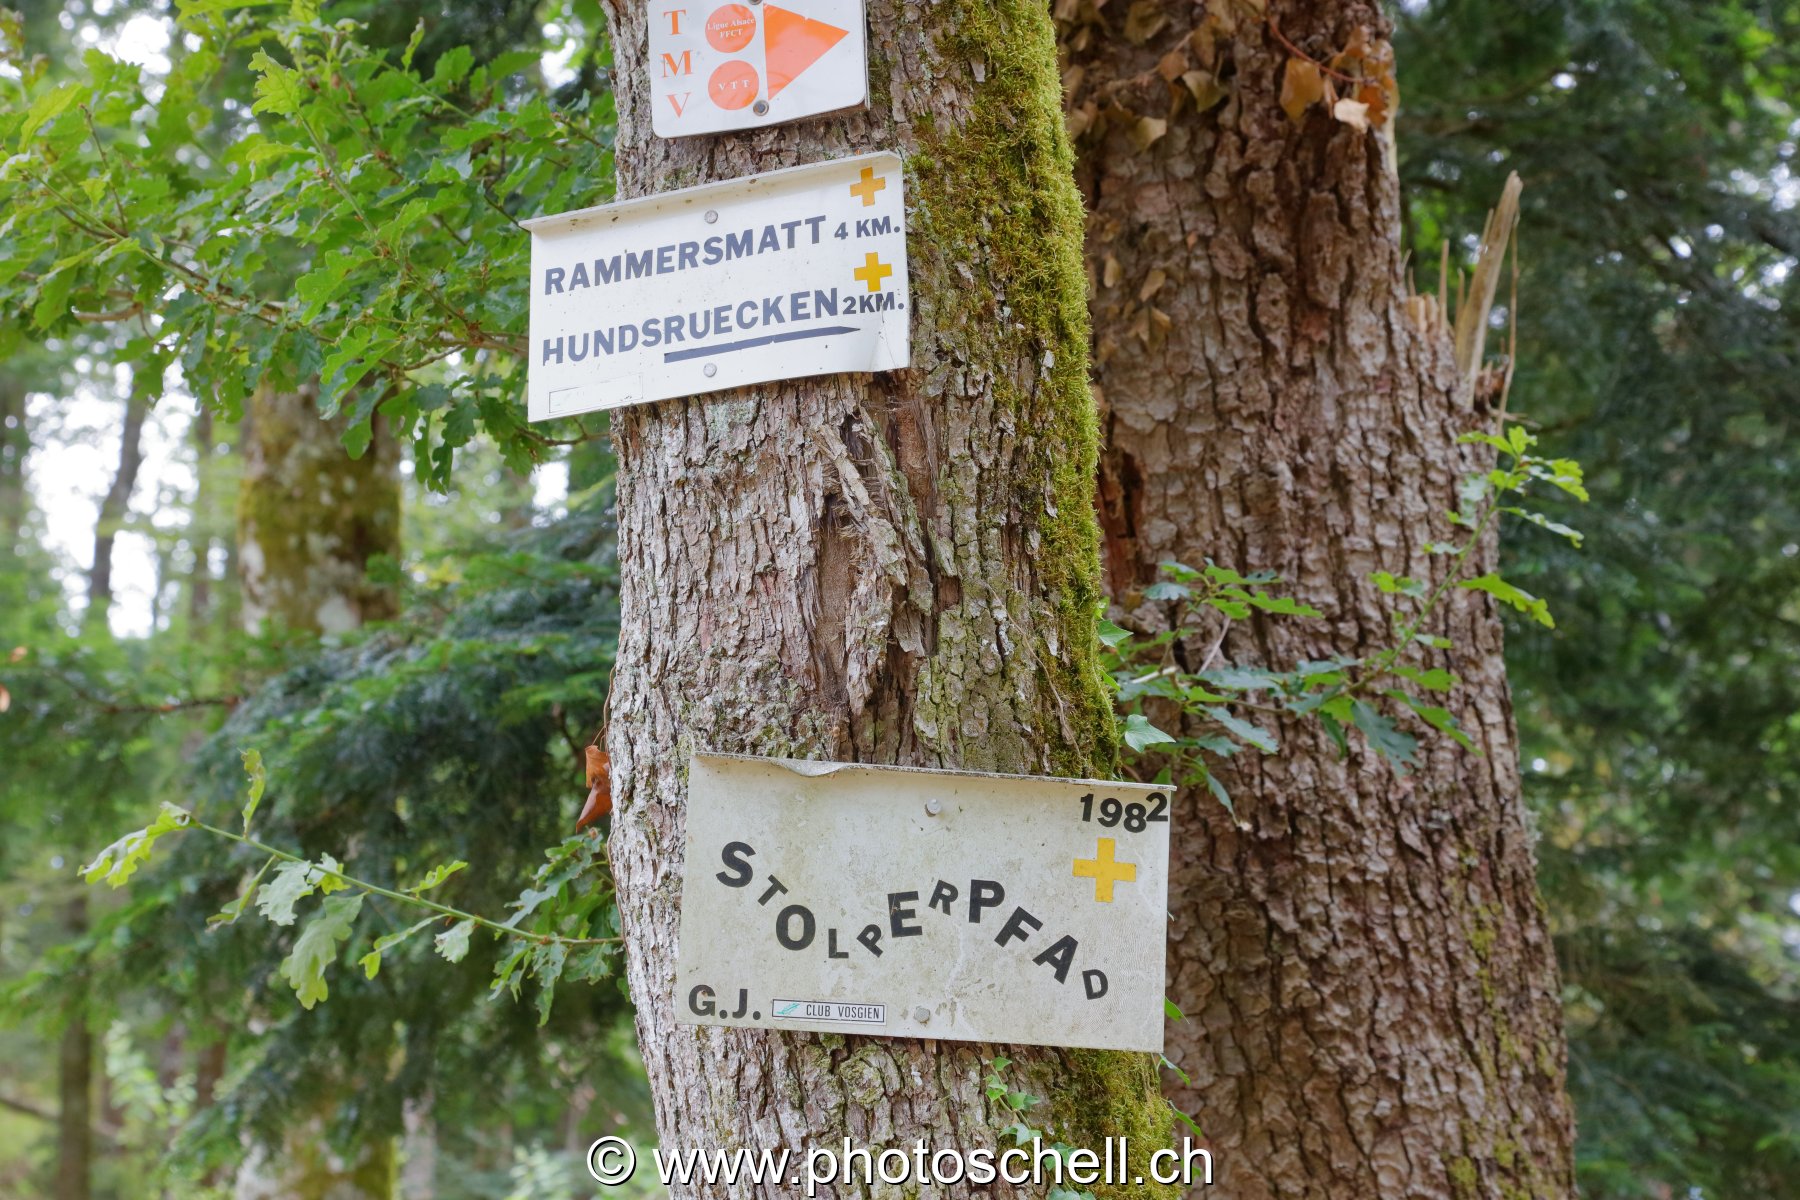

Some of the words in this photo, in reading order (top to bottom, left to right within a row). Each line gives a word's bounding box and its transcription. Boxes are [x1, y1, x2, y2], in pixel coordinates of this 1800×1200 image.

[707, 22, 728, 31] Ligue
[731, 17, 755, 27] Alsace
[544, 214, 827, 296] RAMMERSMATT
[834, 222, 849, 240] 4
[856, 215, 901, 239] KM.
[542, 287, 838, 367] HUNDSRUECKEN
[1079, 792, 1169, 833] 1982
[715, 841, 1109, 1000] STOLPERPFAD
[688, 984, 762, 1020] G.J.
[806, 1004, 831, 1017] CLUB
[838, 1005, 880, 1019] VOSGIEN
